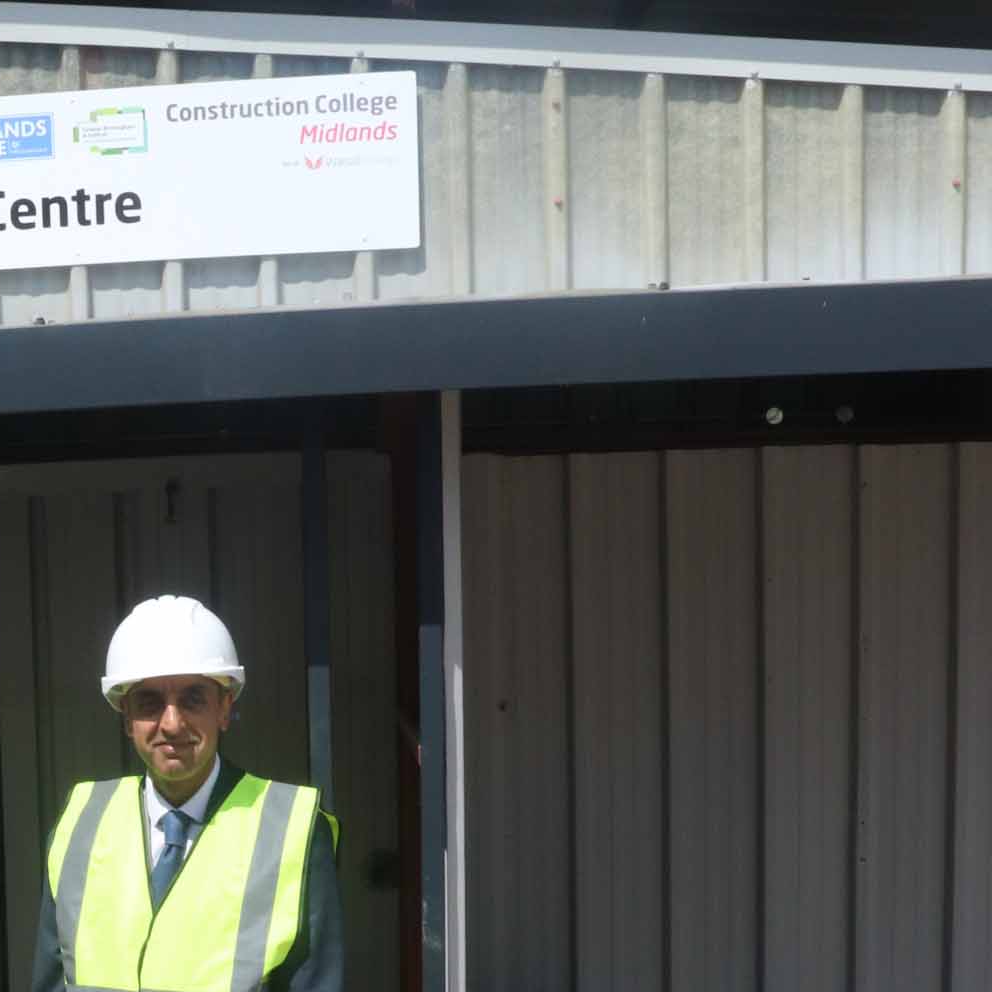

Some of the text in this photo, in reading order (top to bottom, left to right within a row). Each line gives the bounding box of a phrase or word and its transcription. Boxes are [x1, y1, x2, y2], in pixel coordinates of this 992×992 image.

[166, 93, 398, 122] Construction College
[299, 121, 398, 144] Midlands
